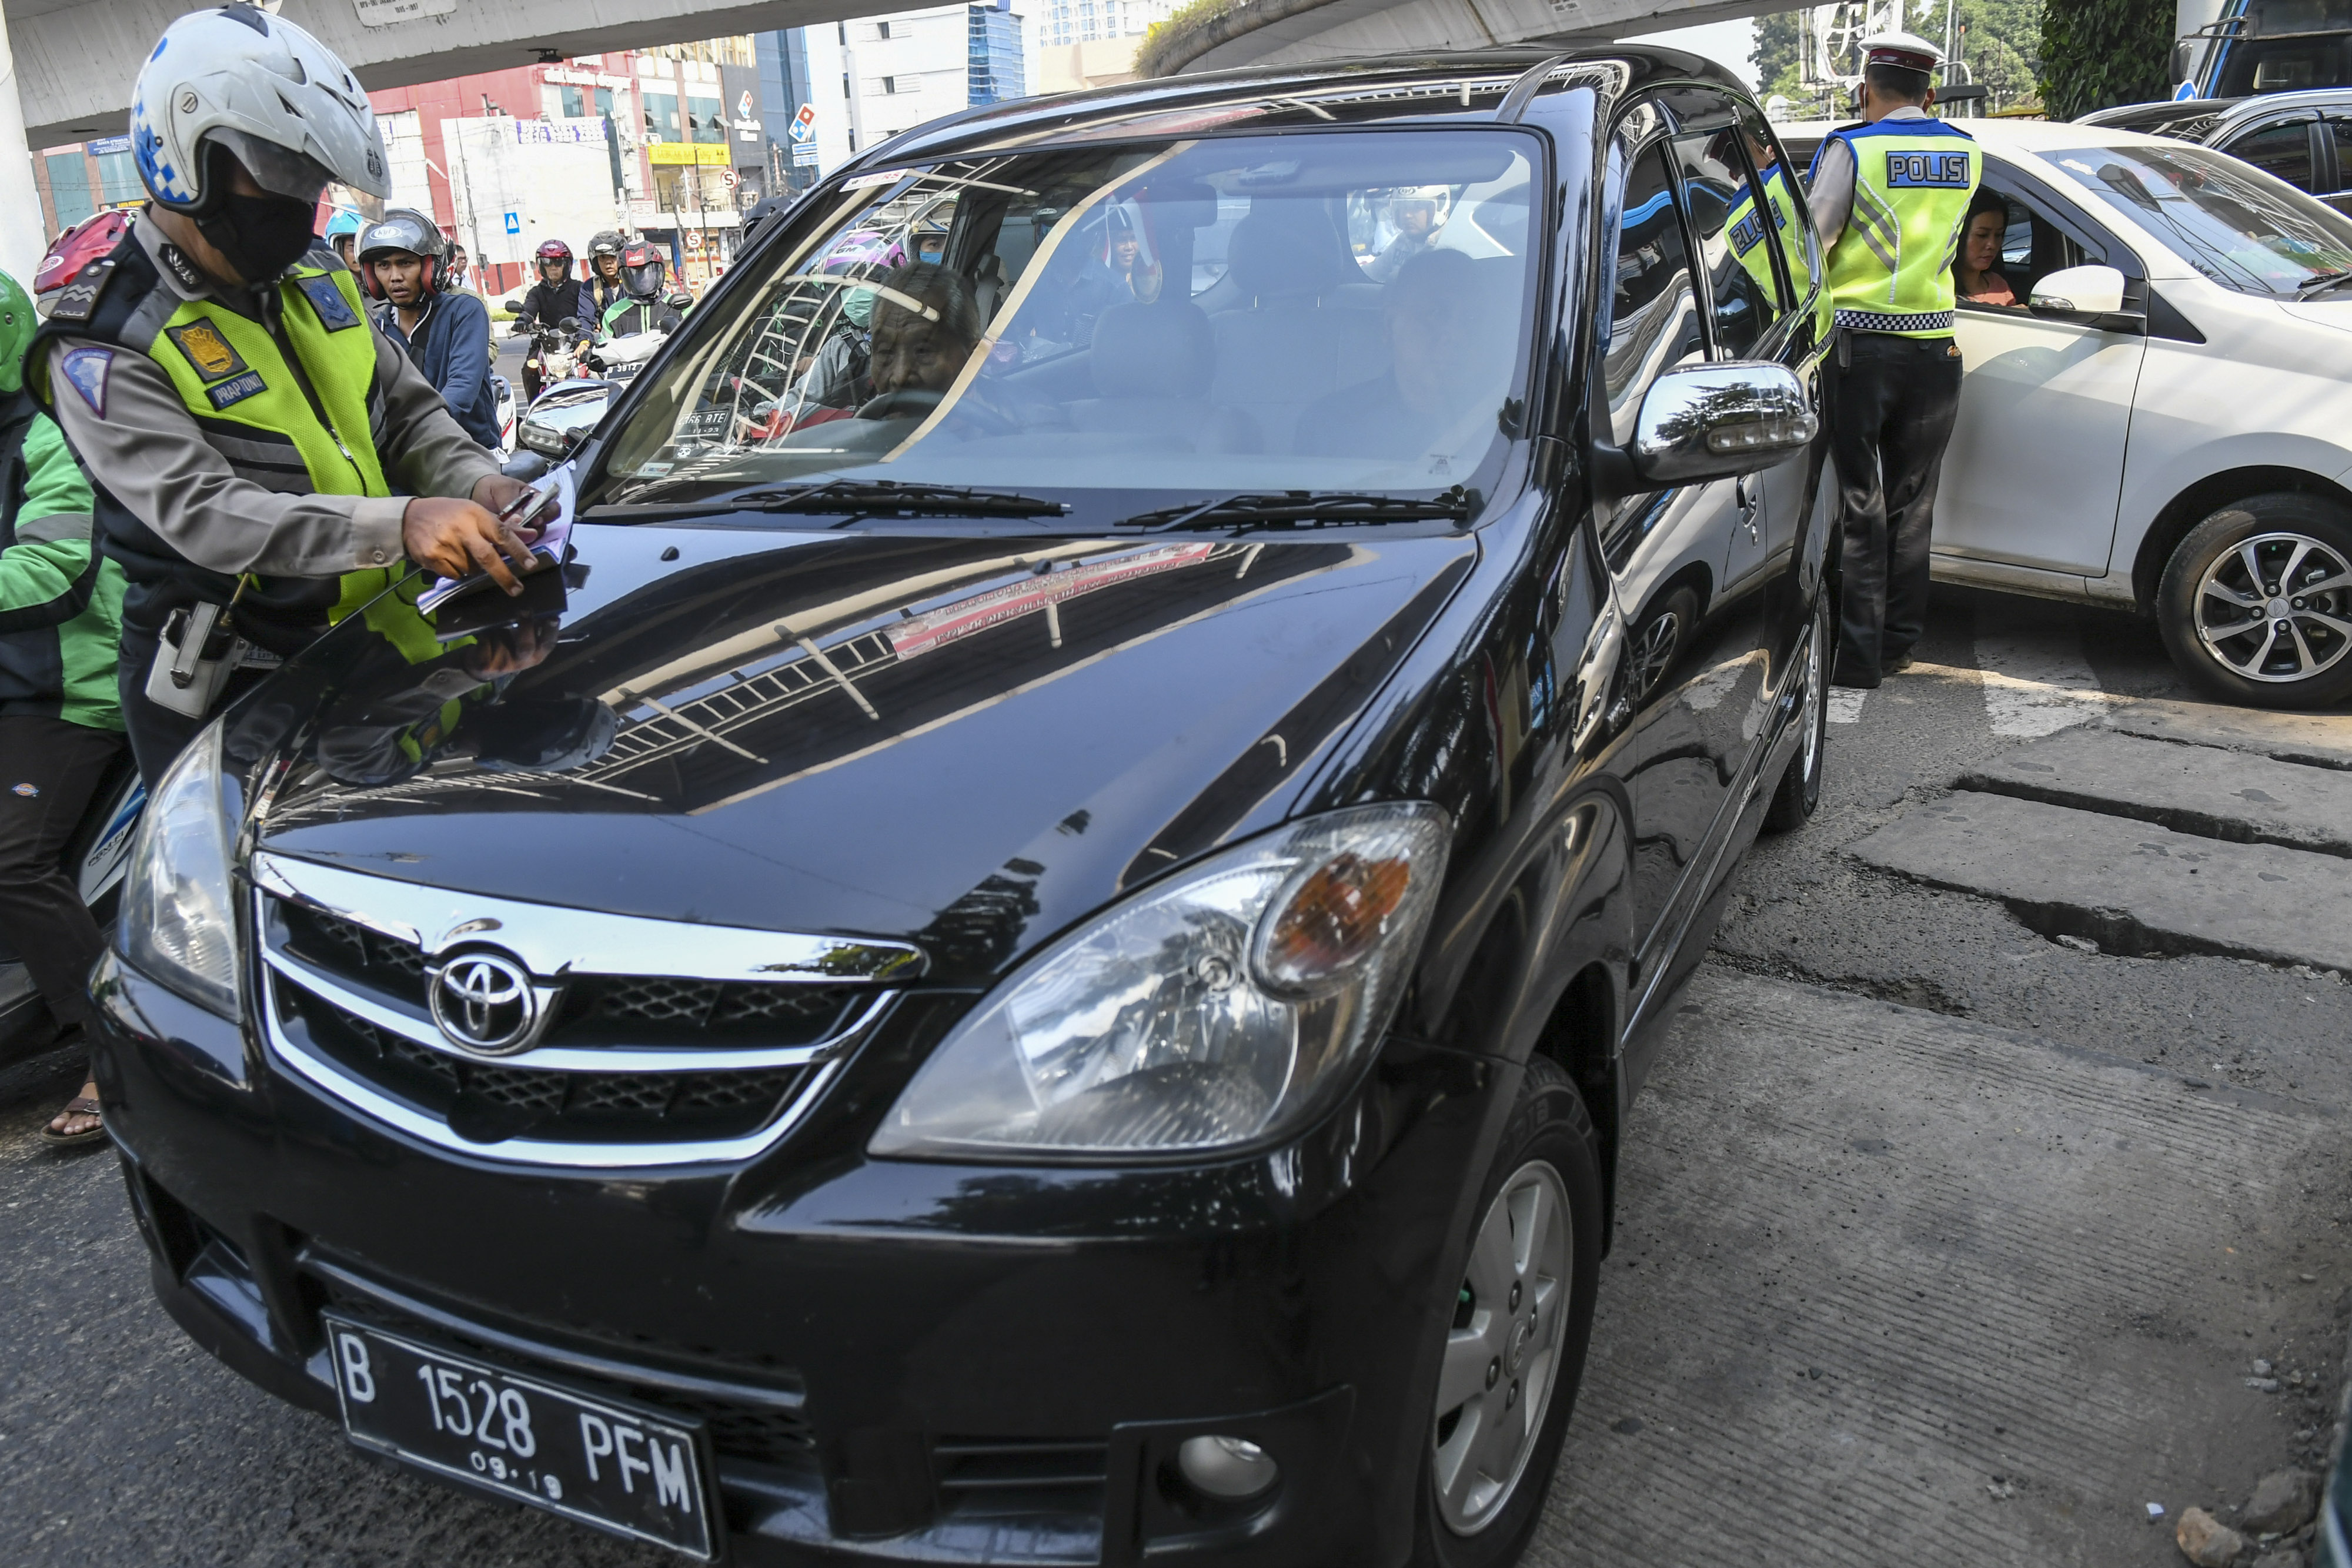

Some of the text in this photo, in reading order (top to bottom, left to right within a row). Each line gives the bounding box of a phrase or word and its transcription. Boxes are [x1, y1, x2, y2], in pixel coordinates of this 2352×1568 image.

[1889, 156, 1969, 183] POLISI
[724, 173, 734, 186] S
[863, 172, 901, 184] PERS
[690, 235, 699, 245] S
[339, 1333, 691, 1513] B 1528 PFM
